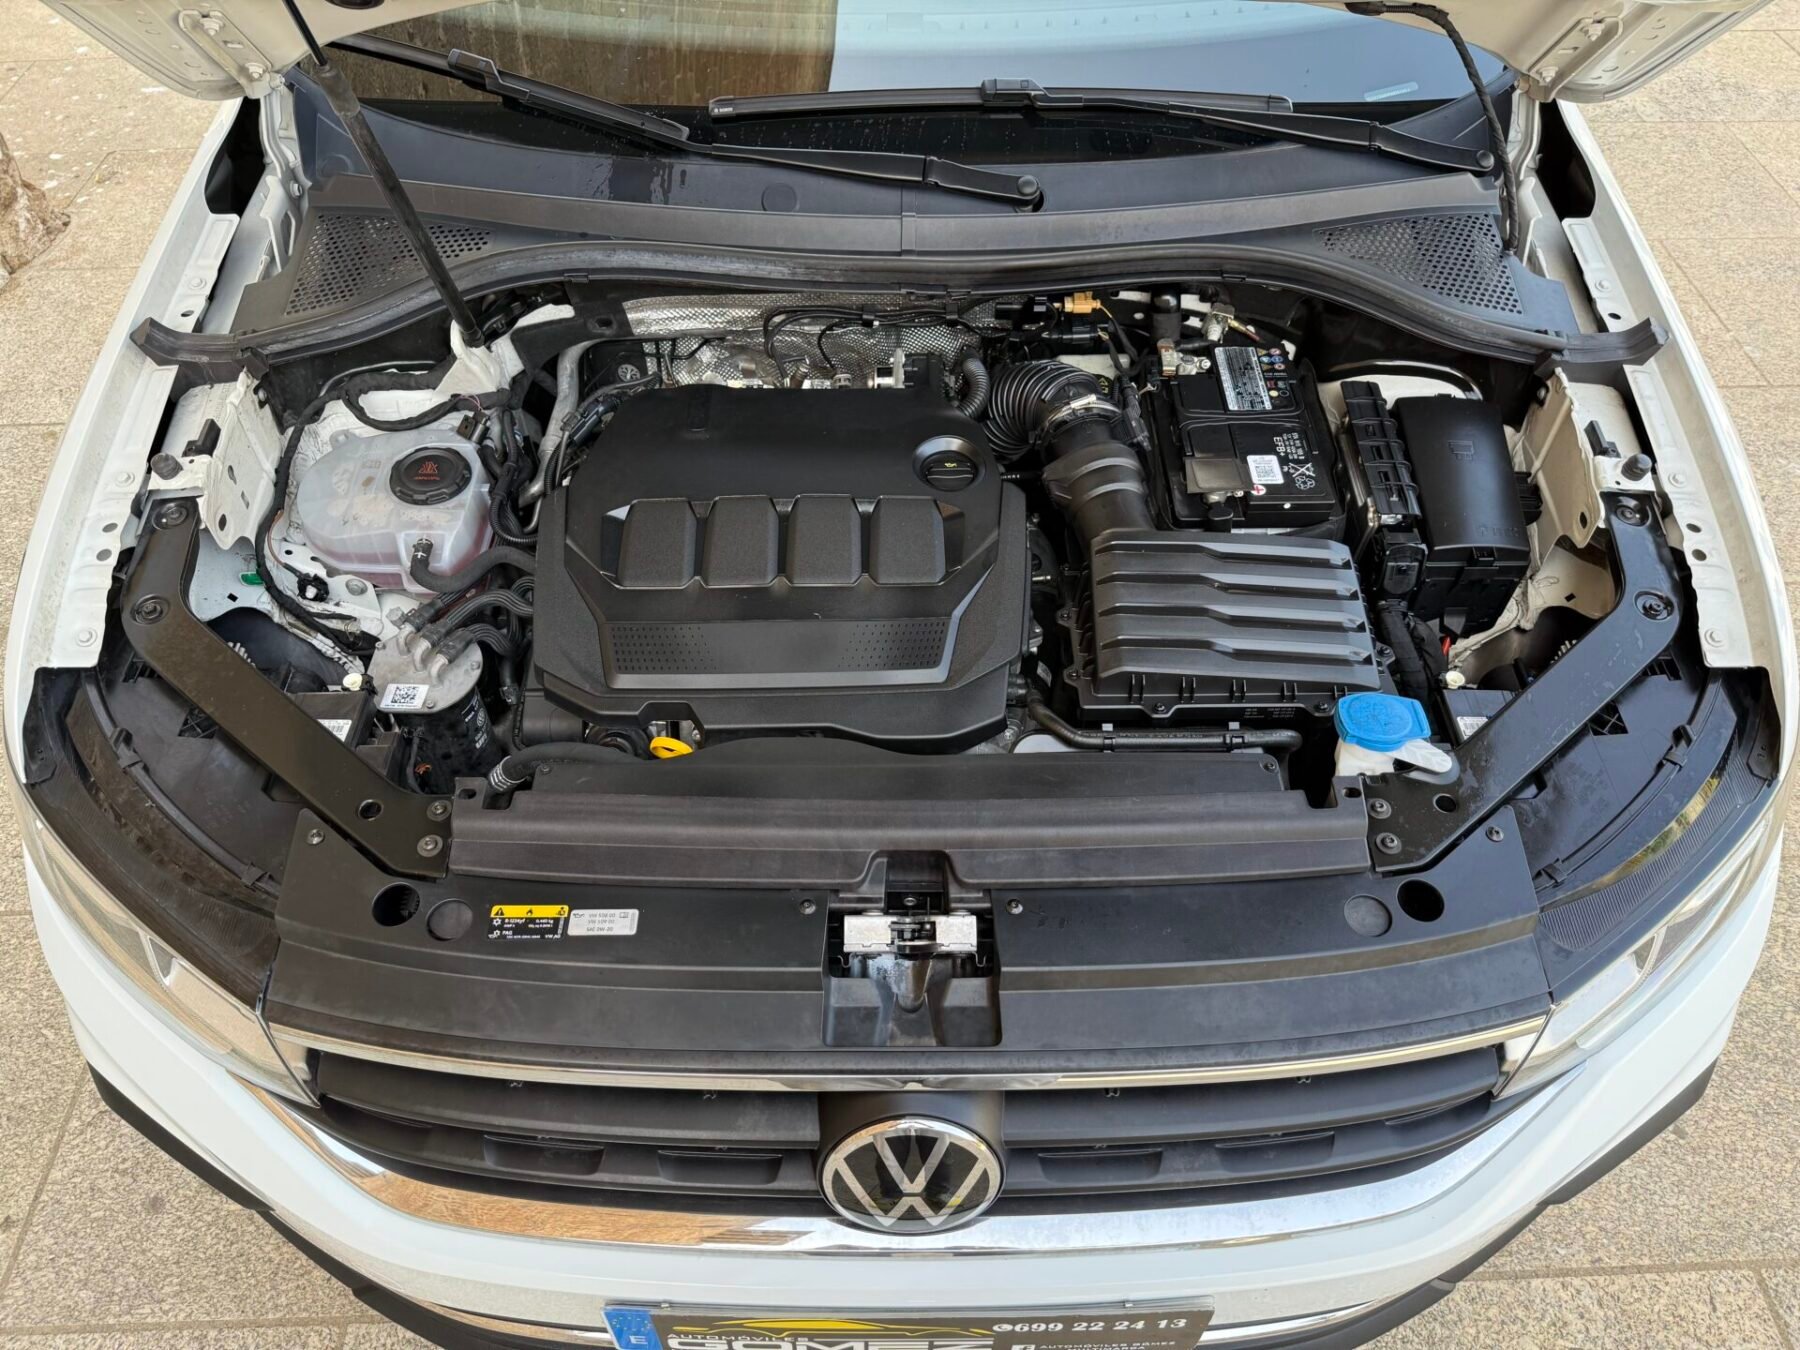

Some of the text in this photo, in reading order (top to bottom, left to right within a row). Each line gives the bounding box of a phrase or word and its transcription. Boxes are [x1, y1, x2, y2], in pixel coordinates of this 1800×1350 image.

[1274, 437, 1286, 457] EFB+
[1014, 1318, 1188, 1333] 699 22 24 13
[630, 1335, 649, 1345] E
[667, 1333, 809, 1343] AUTOMÓVILES
